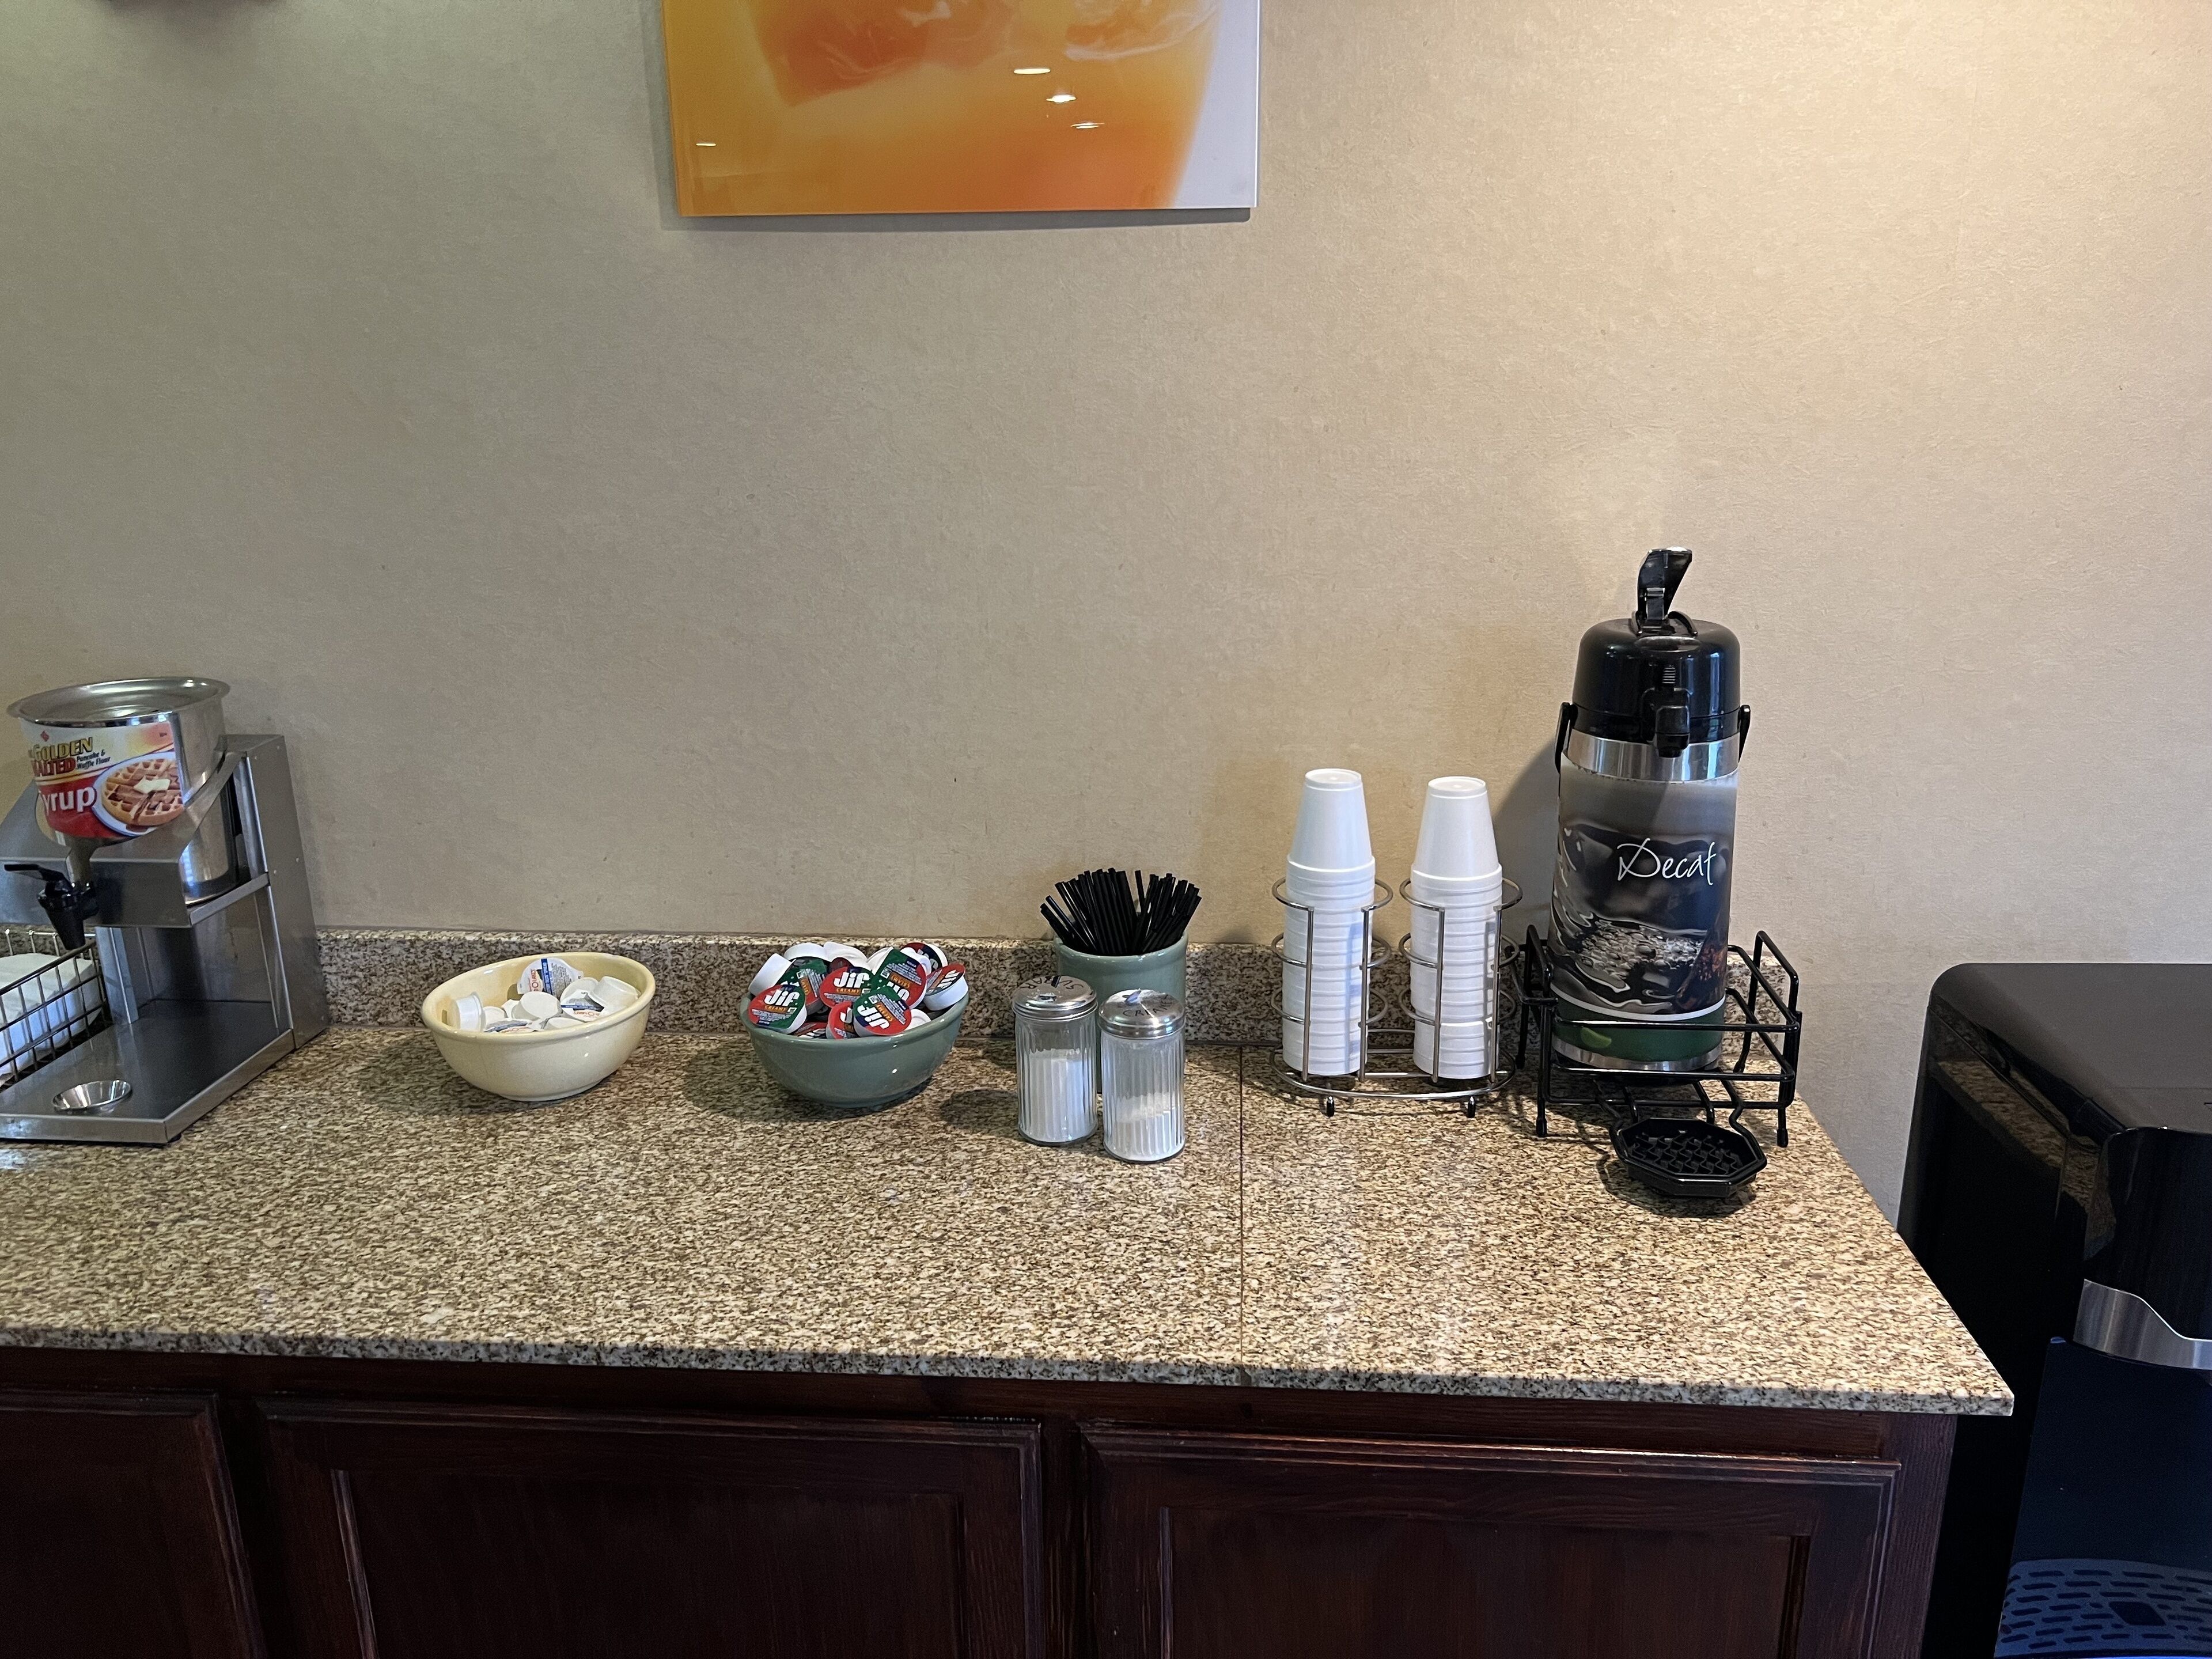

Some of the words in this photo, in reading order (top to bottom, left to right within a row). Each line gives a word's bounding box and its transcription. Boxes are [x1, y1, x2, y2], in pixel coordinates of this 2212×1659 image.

[33, 737, 93, 762] GOLDEN
[96, 757, 111, 765] Flour
[38, 787, 95, 817] yrup
[1617, 838, 1717, 885] Decaf
[834, 972, 870, 988] Jif
[764, 990, 800, 1006] Jif
[857, 1005, 890, 1029] Jif
